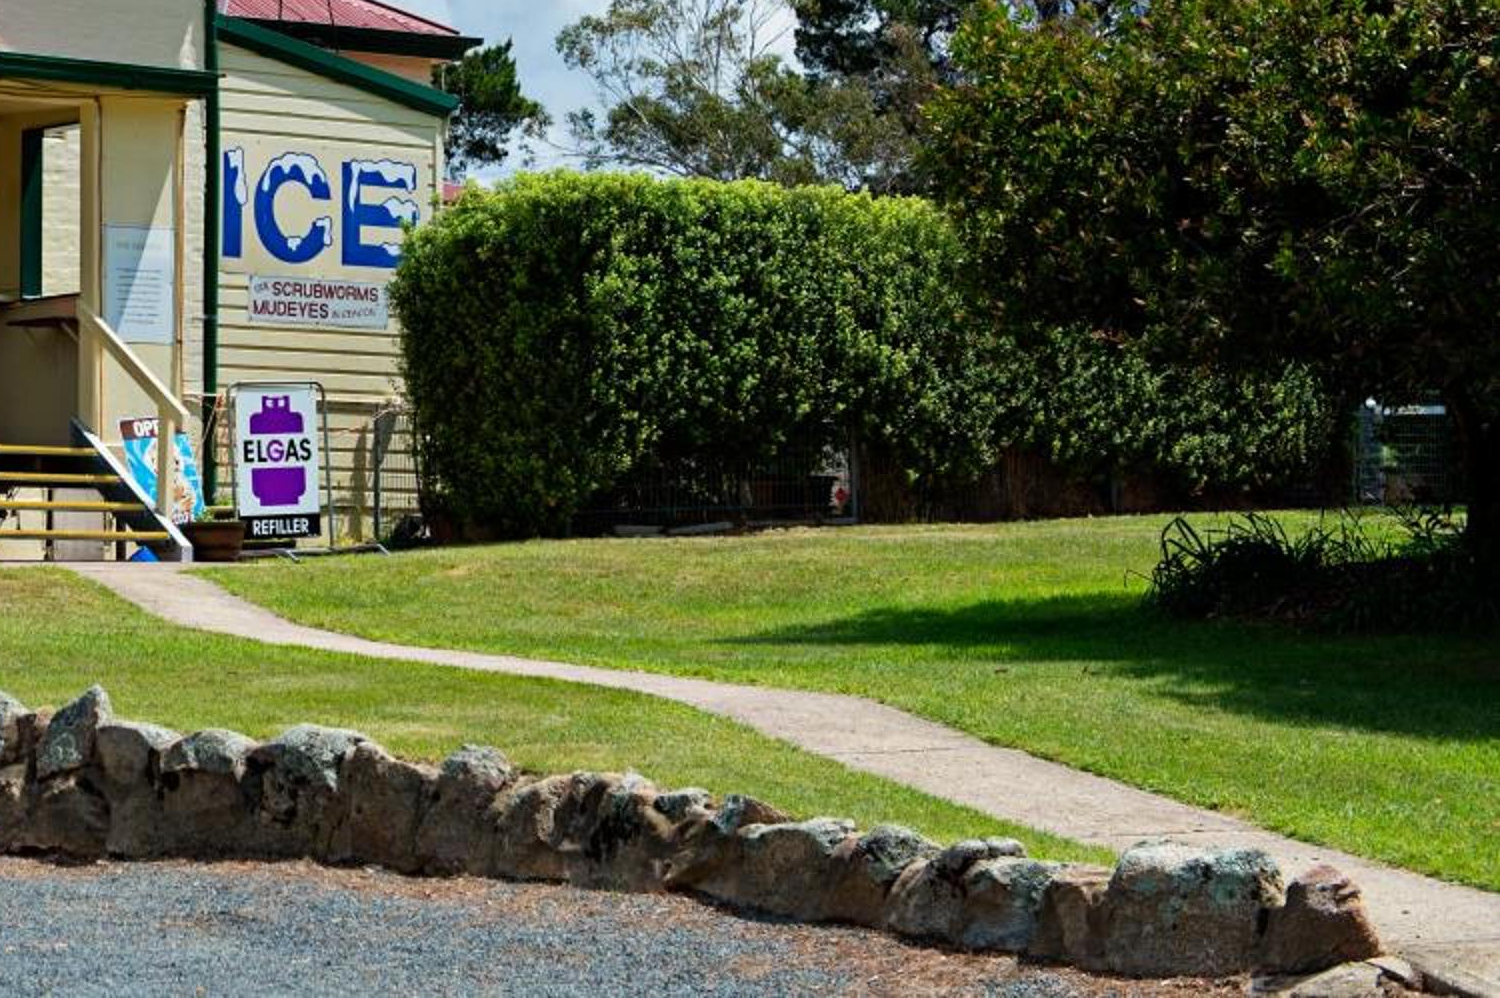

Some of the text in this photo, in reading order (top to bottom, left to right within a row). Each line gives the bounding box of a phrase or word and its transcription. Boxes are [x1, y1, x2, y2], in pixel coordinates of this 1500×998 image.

[222, 146, 420, 268] ICE
[271, 281, 379, 302] SCRUBWORMS
[253, 300, 329, 319] MUDEYES
[243, 438, 312, 463] ELGAS
[252, 518, 309, 536] REFILLER
